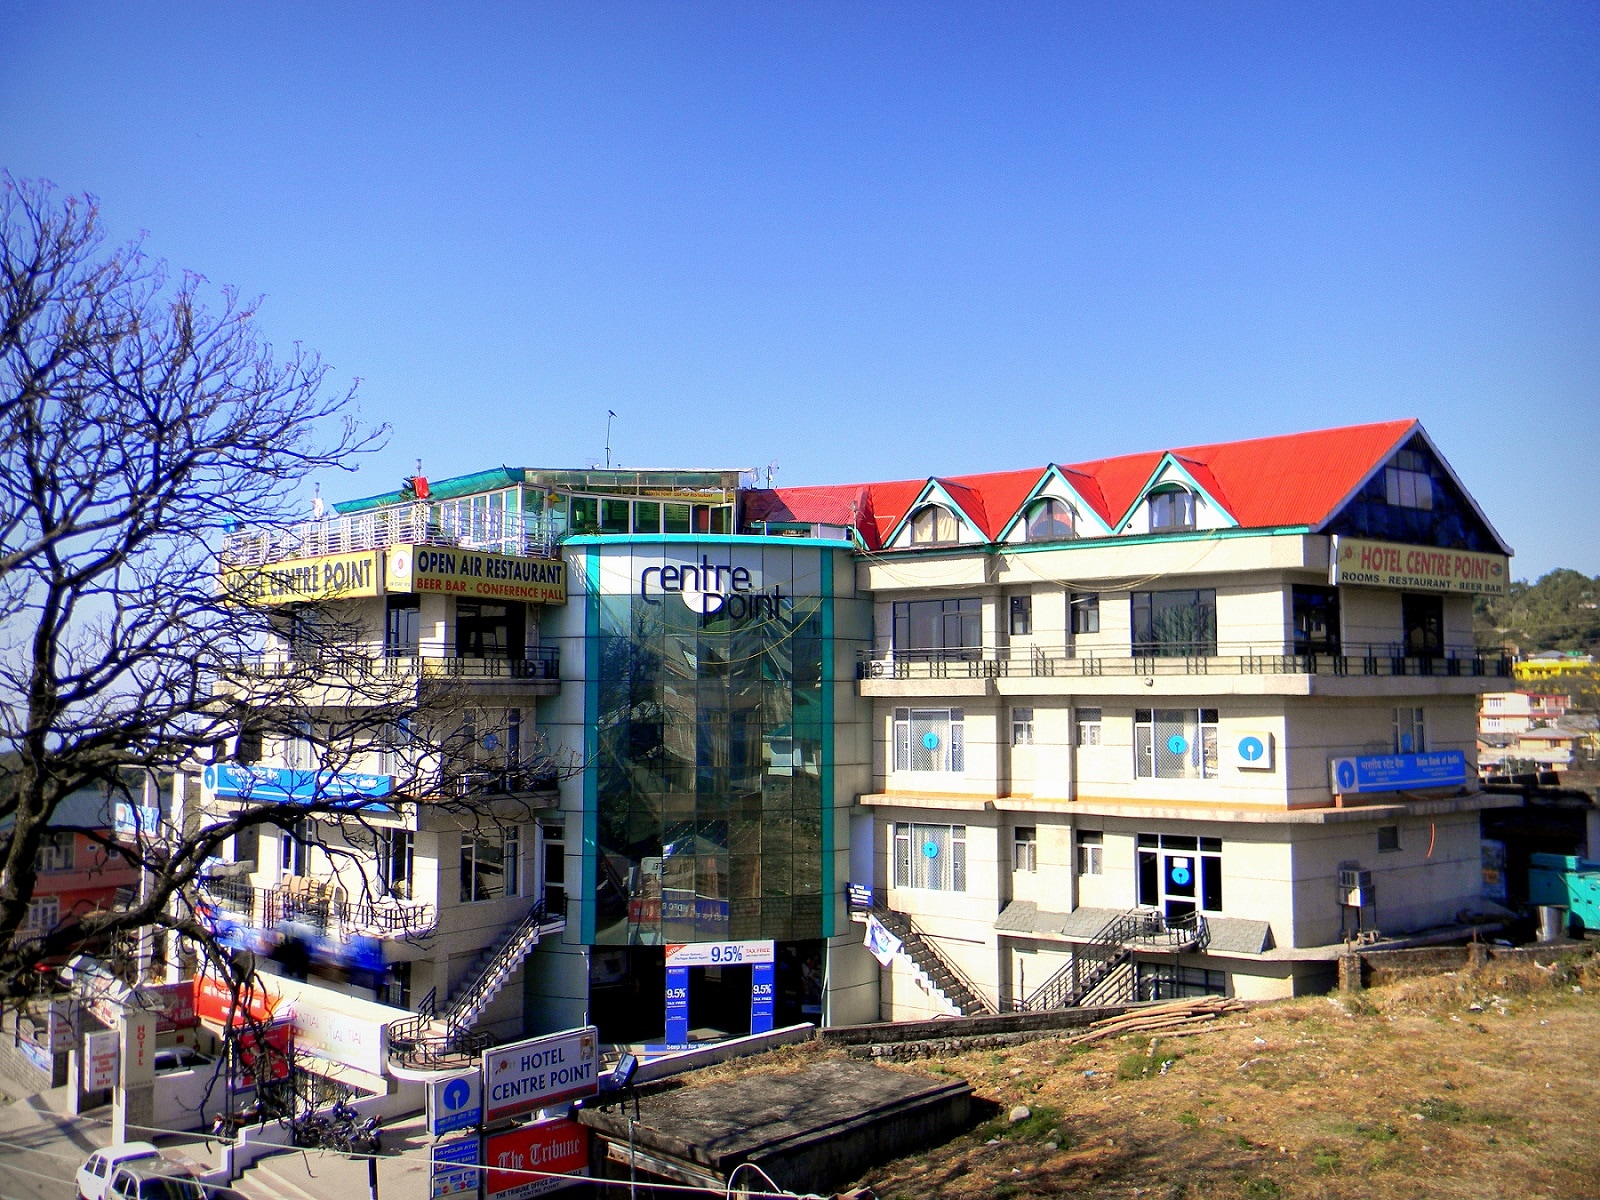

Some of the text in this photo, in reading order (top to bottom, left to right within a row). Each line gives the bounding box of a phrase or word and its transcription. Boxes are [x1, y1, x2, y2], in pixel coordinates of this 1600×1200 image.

[324, 559, 372, 592] POINT
[418, 550, 562, 585] OPEN AIR RESTAURANT
[641, 554, 751, 605] centre
[1361, 546, 1490, 580] HOTEL CENTRE POINT
[416, 577, 442, 591] BEER
[445, 580, 467, 593] BAR
[476, 582, 538, 598] CONFERENCE
[541, 589, 564, 601] HALL
[1342, 572, 1501, 593] ROOMS RESTAURANT BEER BAR
[703, 582, 785, 629] point
[137, 1025, 145, 1066] HOTEL
[521, 1048, 565, 1072] HOTEL
[492, 1074, 546, 1101] CENTRE
[551, 1063, 592, 1087] POINT
[444, 1147, 463, 1155] HOUR
[463, 1143, 478, 1151] ATM
[498, 1138, 580, 1175] The Tribune
[496, 1190, 506, 1200] THE
[508, 1185, 529, 1197] TRIBUNE
[531, 1180, 548, 1189] OFFICE
[543, 1182, 560, 1191] POINT
